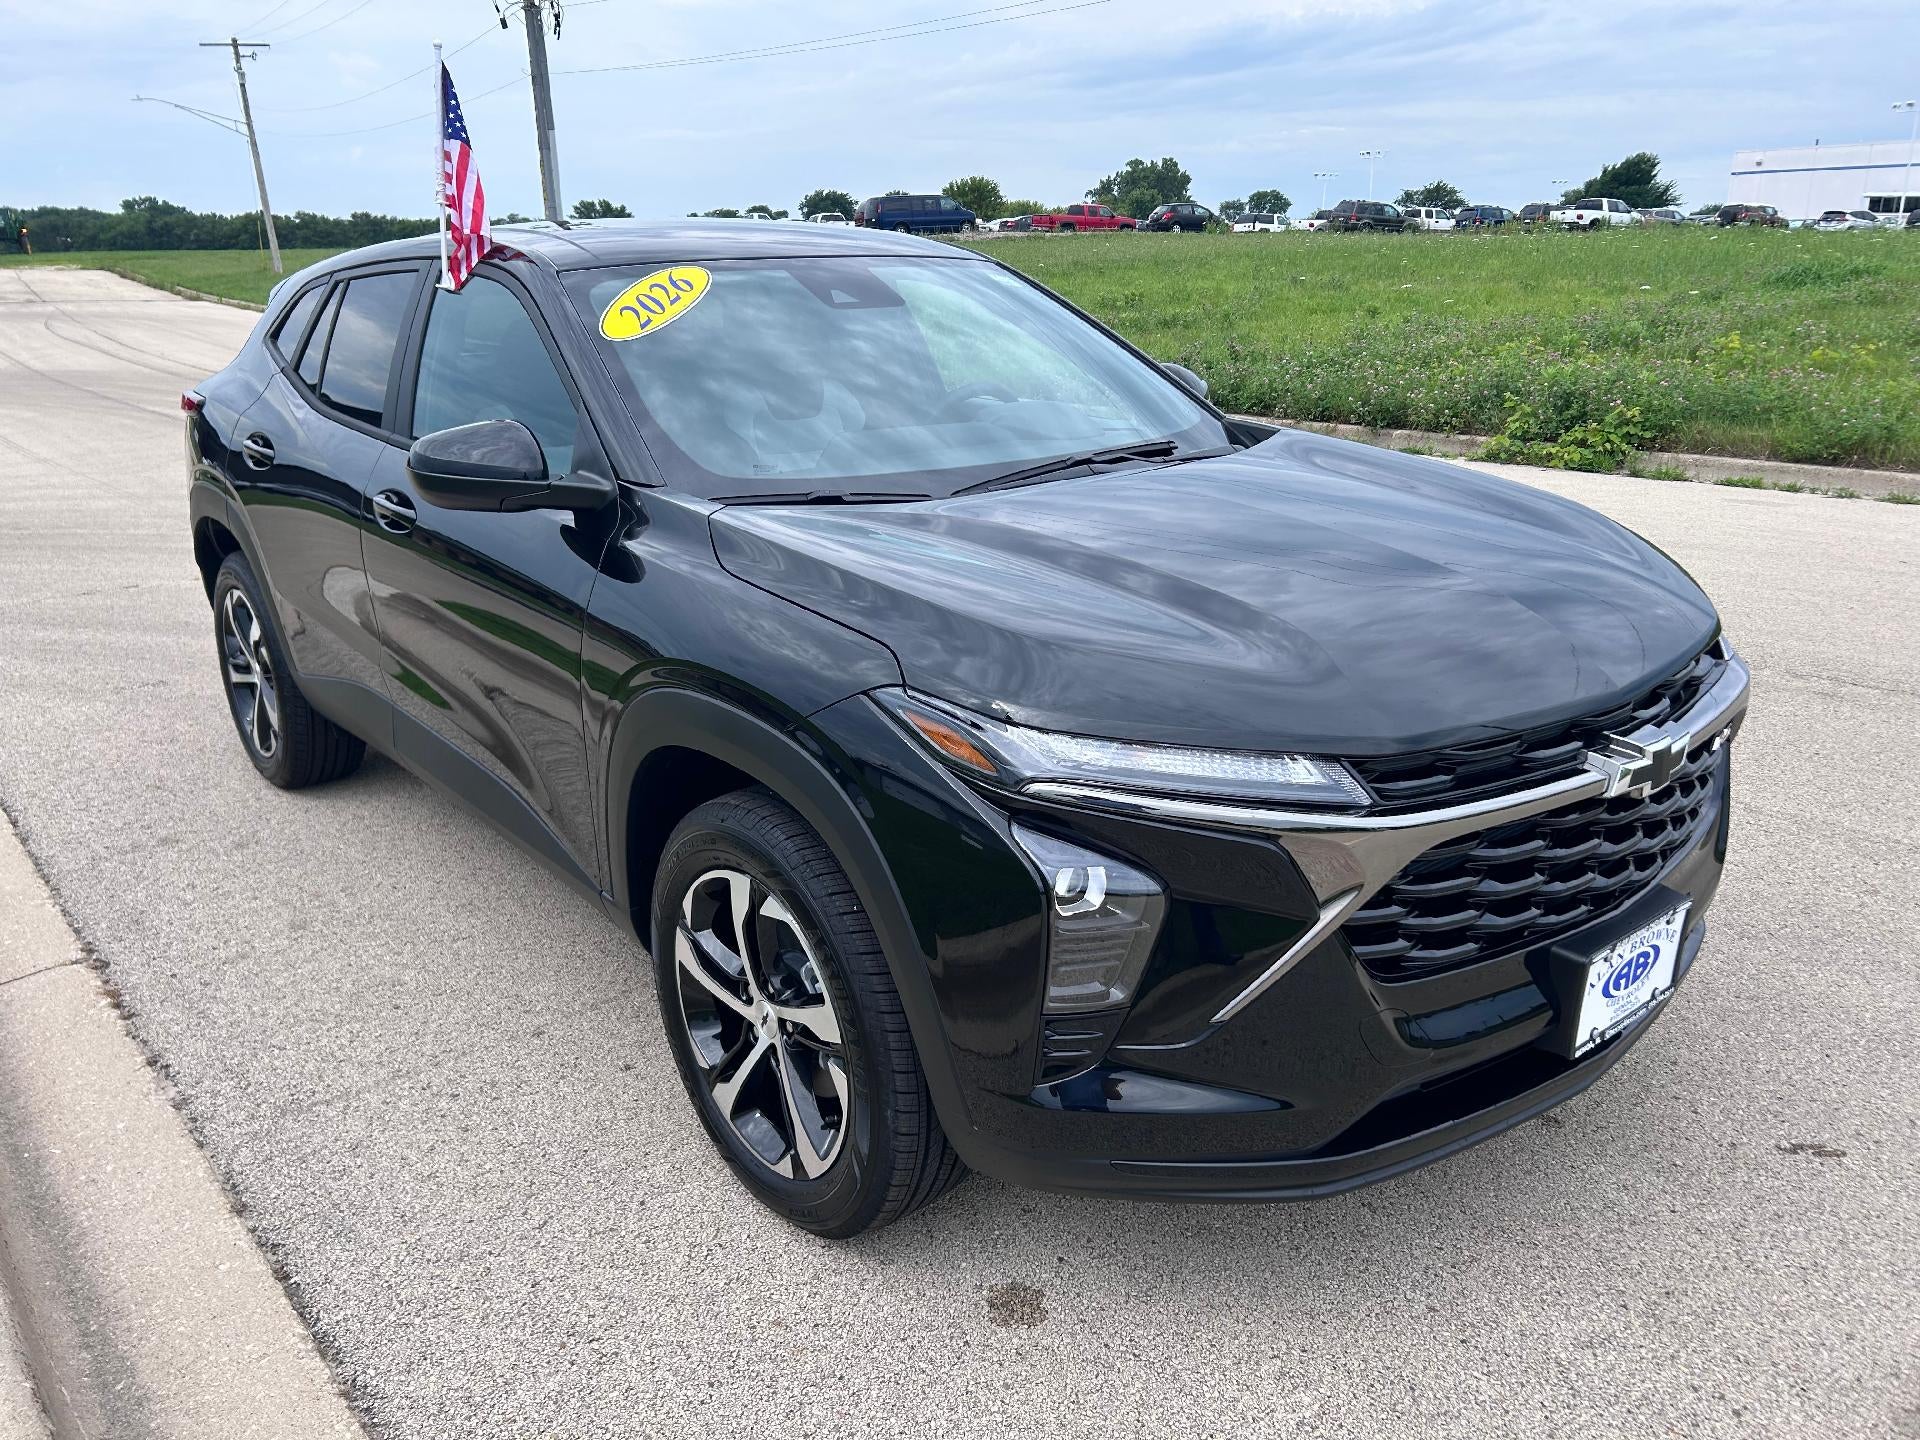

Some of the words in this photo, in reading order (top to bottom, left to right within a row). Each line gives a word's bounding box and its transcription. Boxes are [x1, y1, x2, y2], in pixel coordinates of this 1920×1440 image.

[619, 271, 694, 331] 2026
[1630, 927, 1677, 954] BROWNE
[1612, 950, 1651, 992] AB
